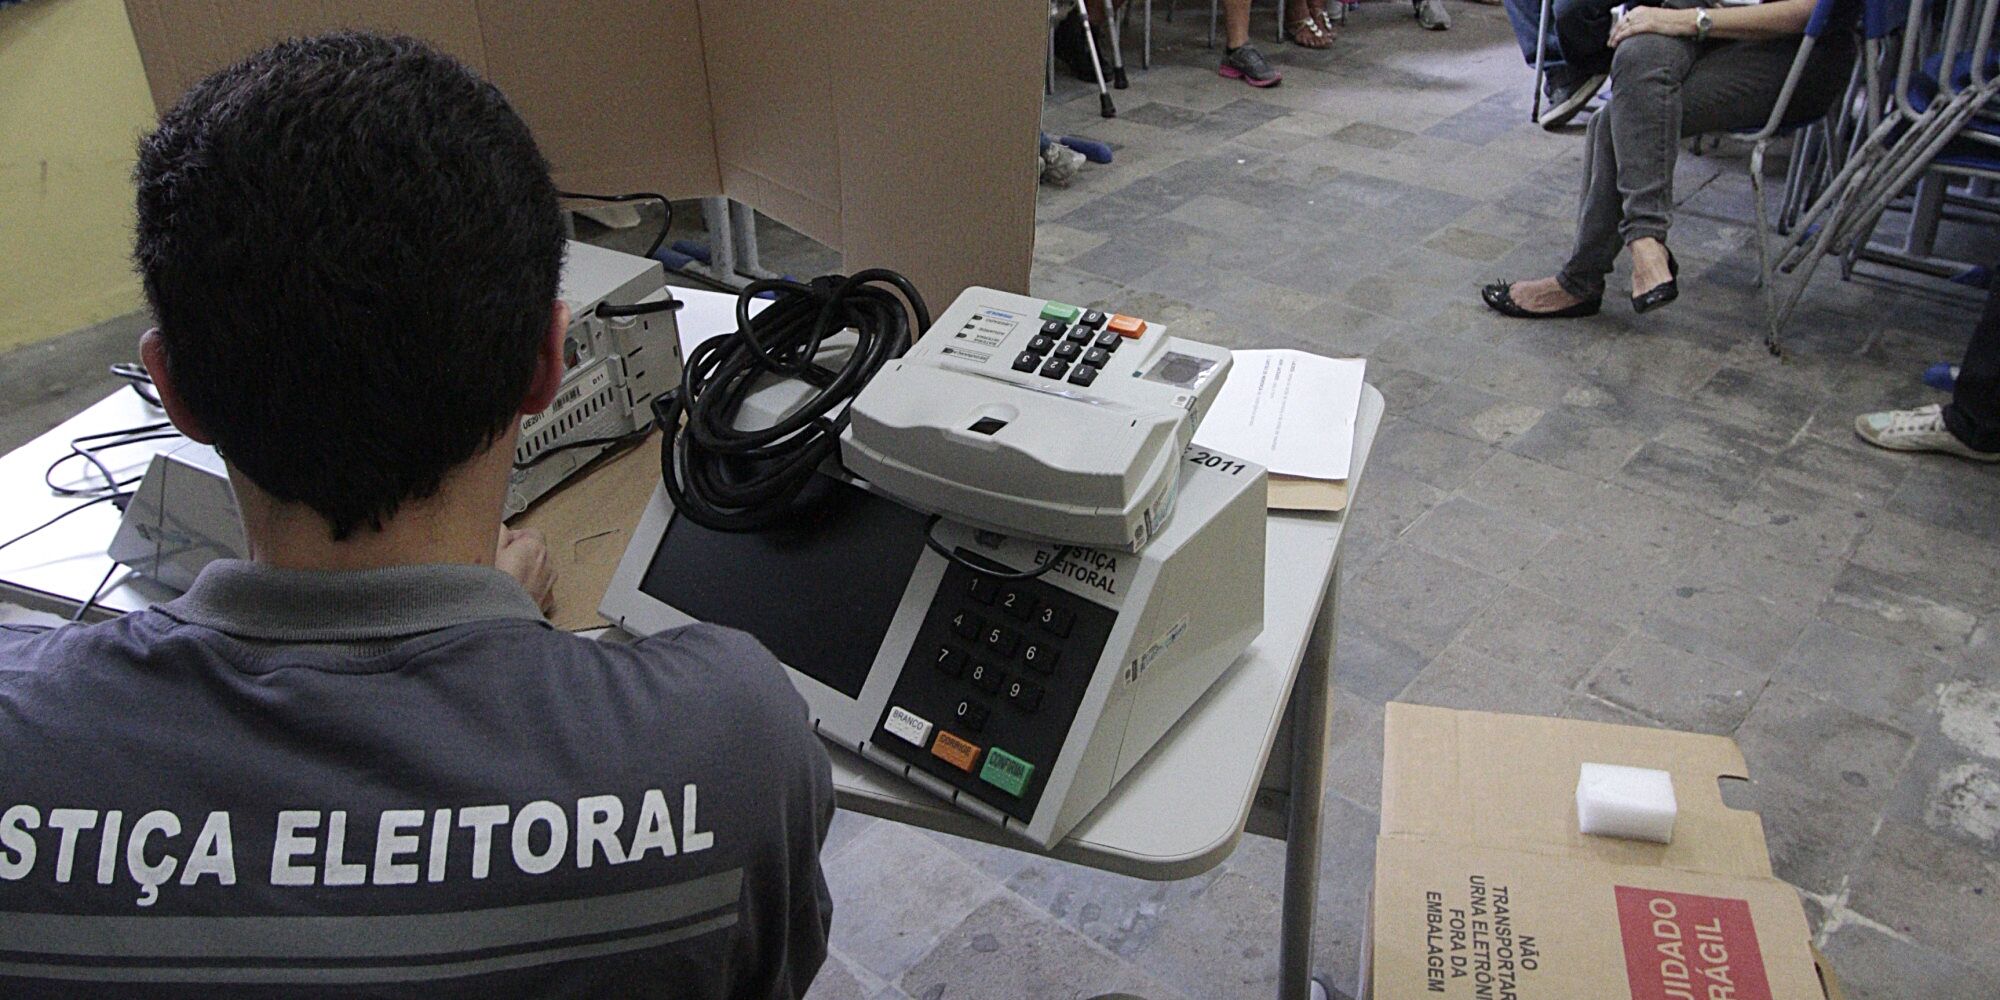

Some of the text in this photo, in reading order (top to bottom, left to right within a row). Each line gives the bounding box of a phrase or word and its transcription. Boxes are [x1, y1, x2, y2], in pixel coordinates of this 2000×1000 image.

[1088, 312, 1097, 320] 0
[1048, 322, 1057, 330] 9
[1035, 338, 1044, 346] 6
[1062, 344, 1071, 352] 5
[1021, 354, 1030, 363] 3
[1050, 361, 1059, 369] 2
[1189, 451, 1246, 476] 2011
[1053, 545, 1117, 573] STIÇA
[970, 578, 979, 591] 1
[1004, 593, 1016, 607] 2
[953, 614, 964, 627] 4
[1042, 608, 1053, 622] 3
[989, 629, 1000, 643] 5
[938, 648, 949, 662] 7
[1026, 646, 1037, 660] 6
[973, 666, 984, 680] 8
[1009, 683, 1020, 697] 9
[957, 702, 968, 716] 0
[892, 710, 924, 731] BRANCO
[270, 783, 715, 886] ELEITORAL
[1469, 875, 1487, 916] URNA
[1426, 891, 1445, 993] EMBALAGEM
[1449, 908, 1468, 978] FORA DA
[1492, 886, 1517, 1000] TRANSPORTAR
[1518, 934, 1540, 971] NÃO
